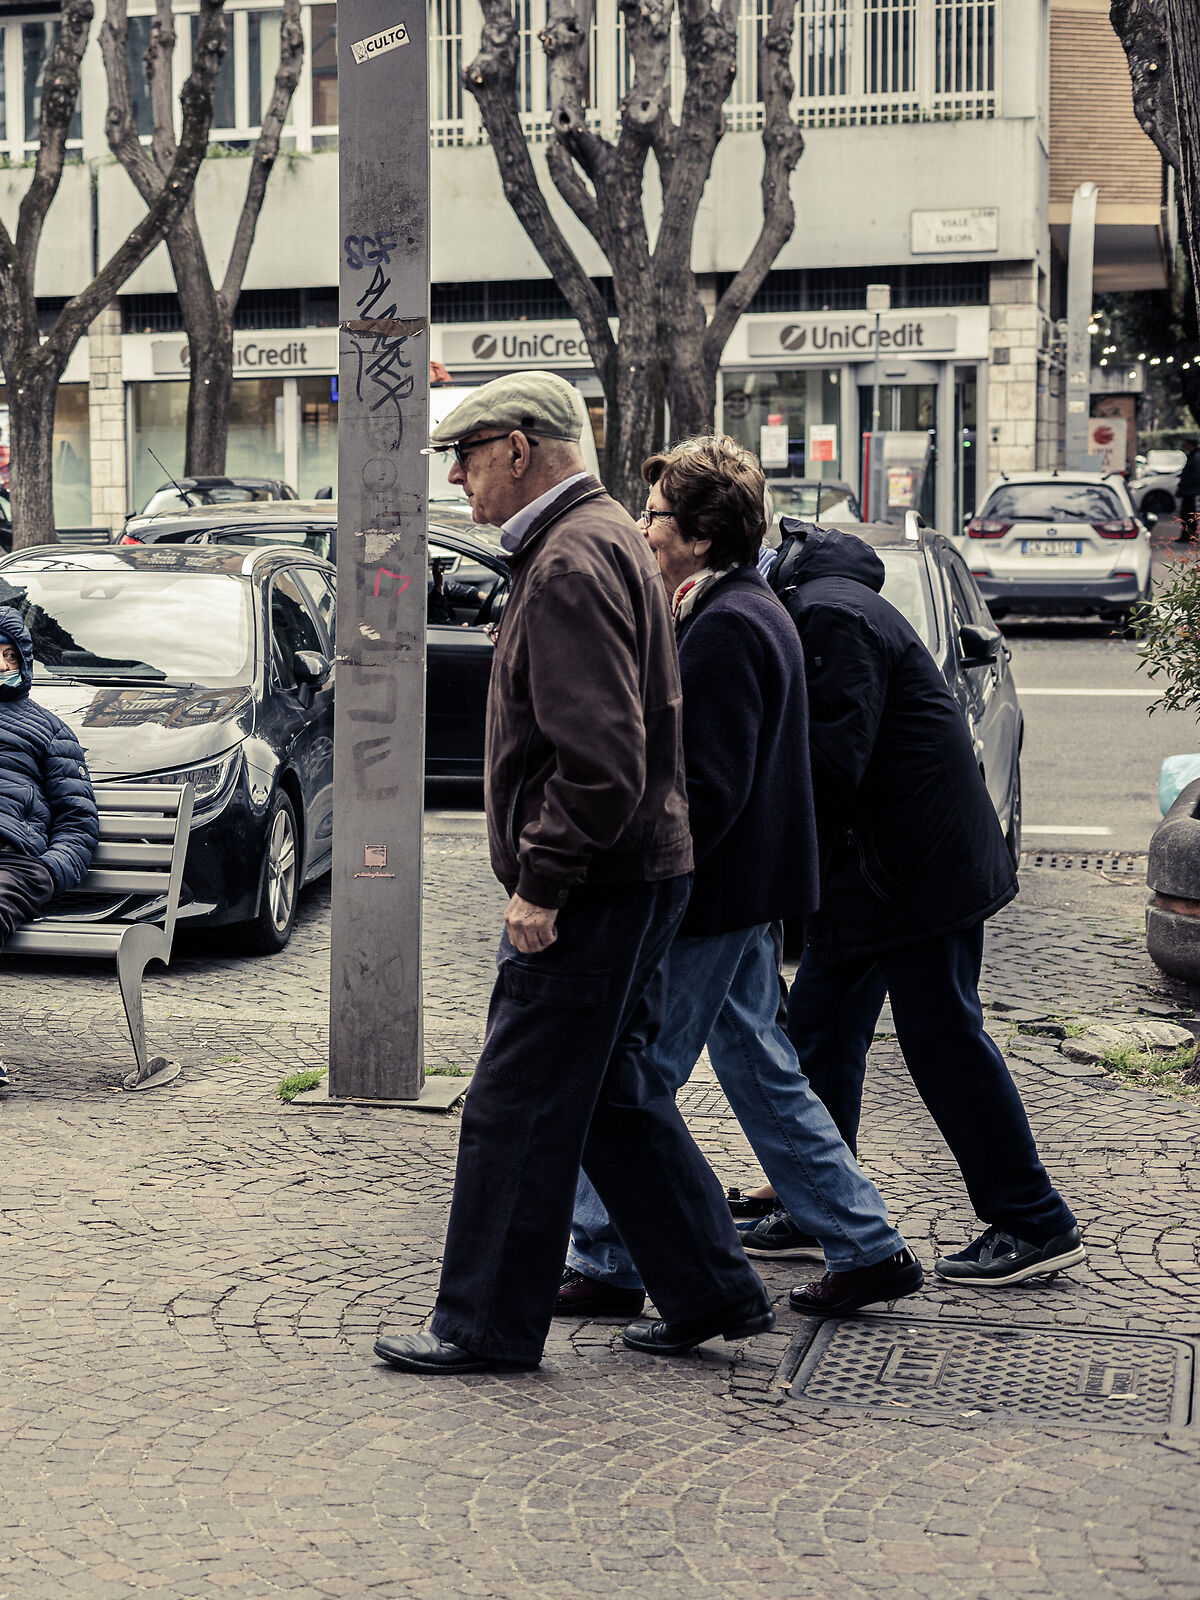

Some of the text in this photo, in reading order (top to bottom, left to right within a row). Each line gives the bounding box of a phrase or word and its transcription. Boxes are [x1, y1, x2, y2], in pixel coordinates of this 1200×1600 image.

[366, 28, 406, 52] CULTO
[503, 334, 589, 358] UniCre
[812, 323, 924, 349] UniCredit
[232, 342, 307, 366] iCredit
